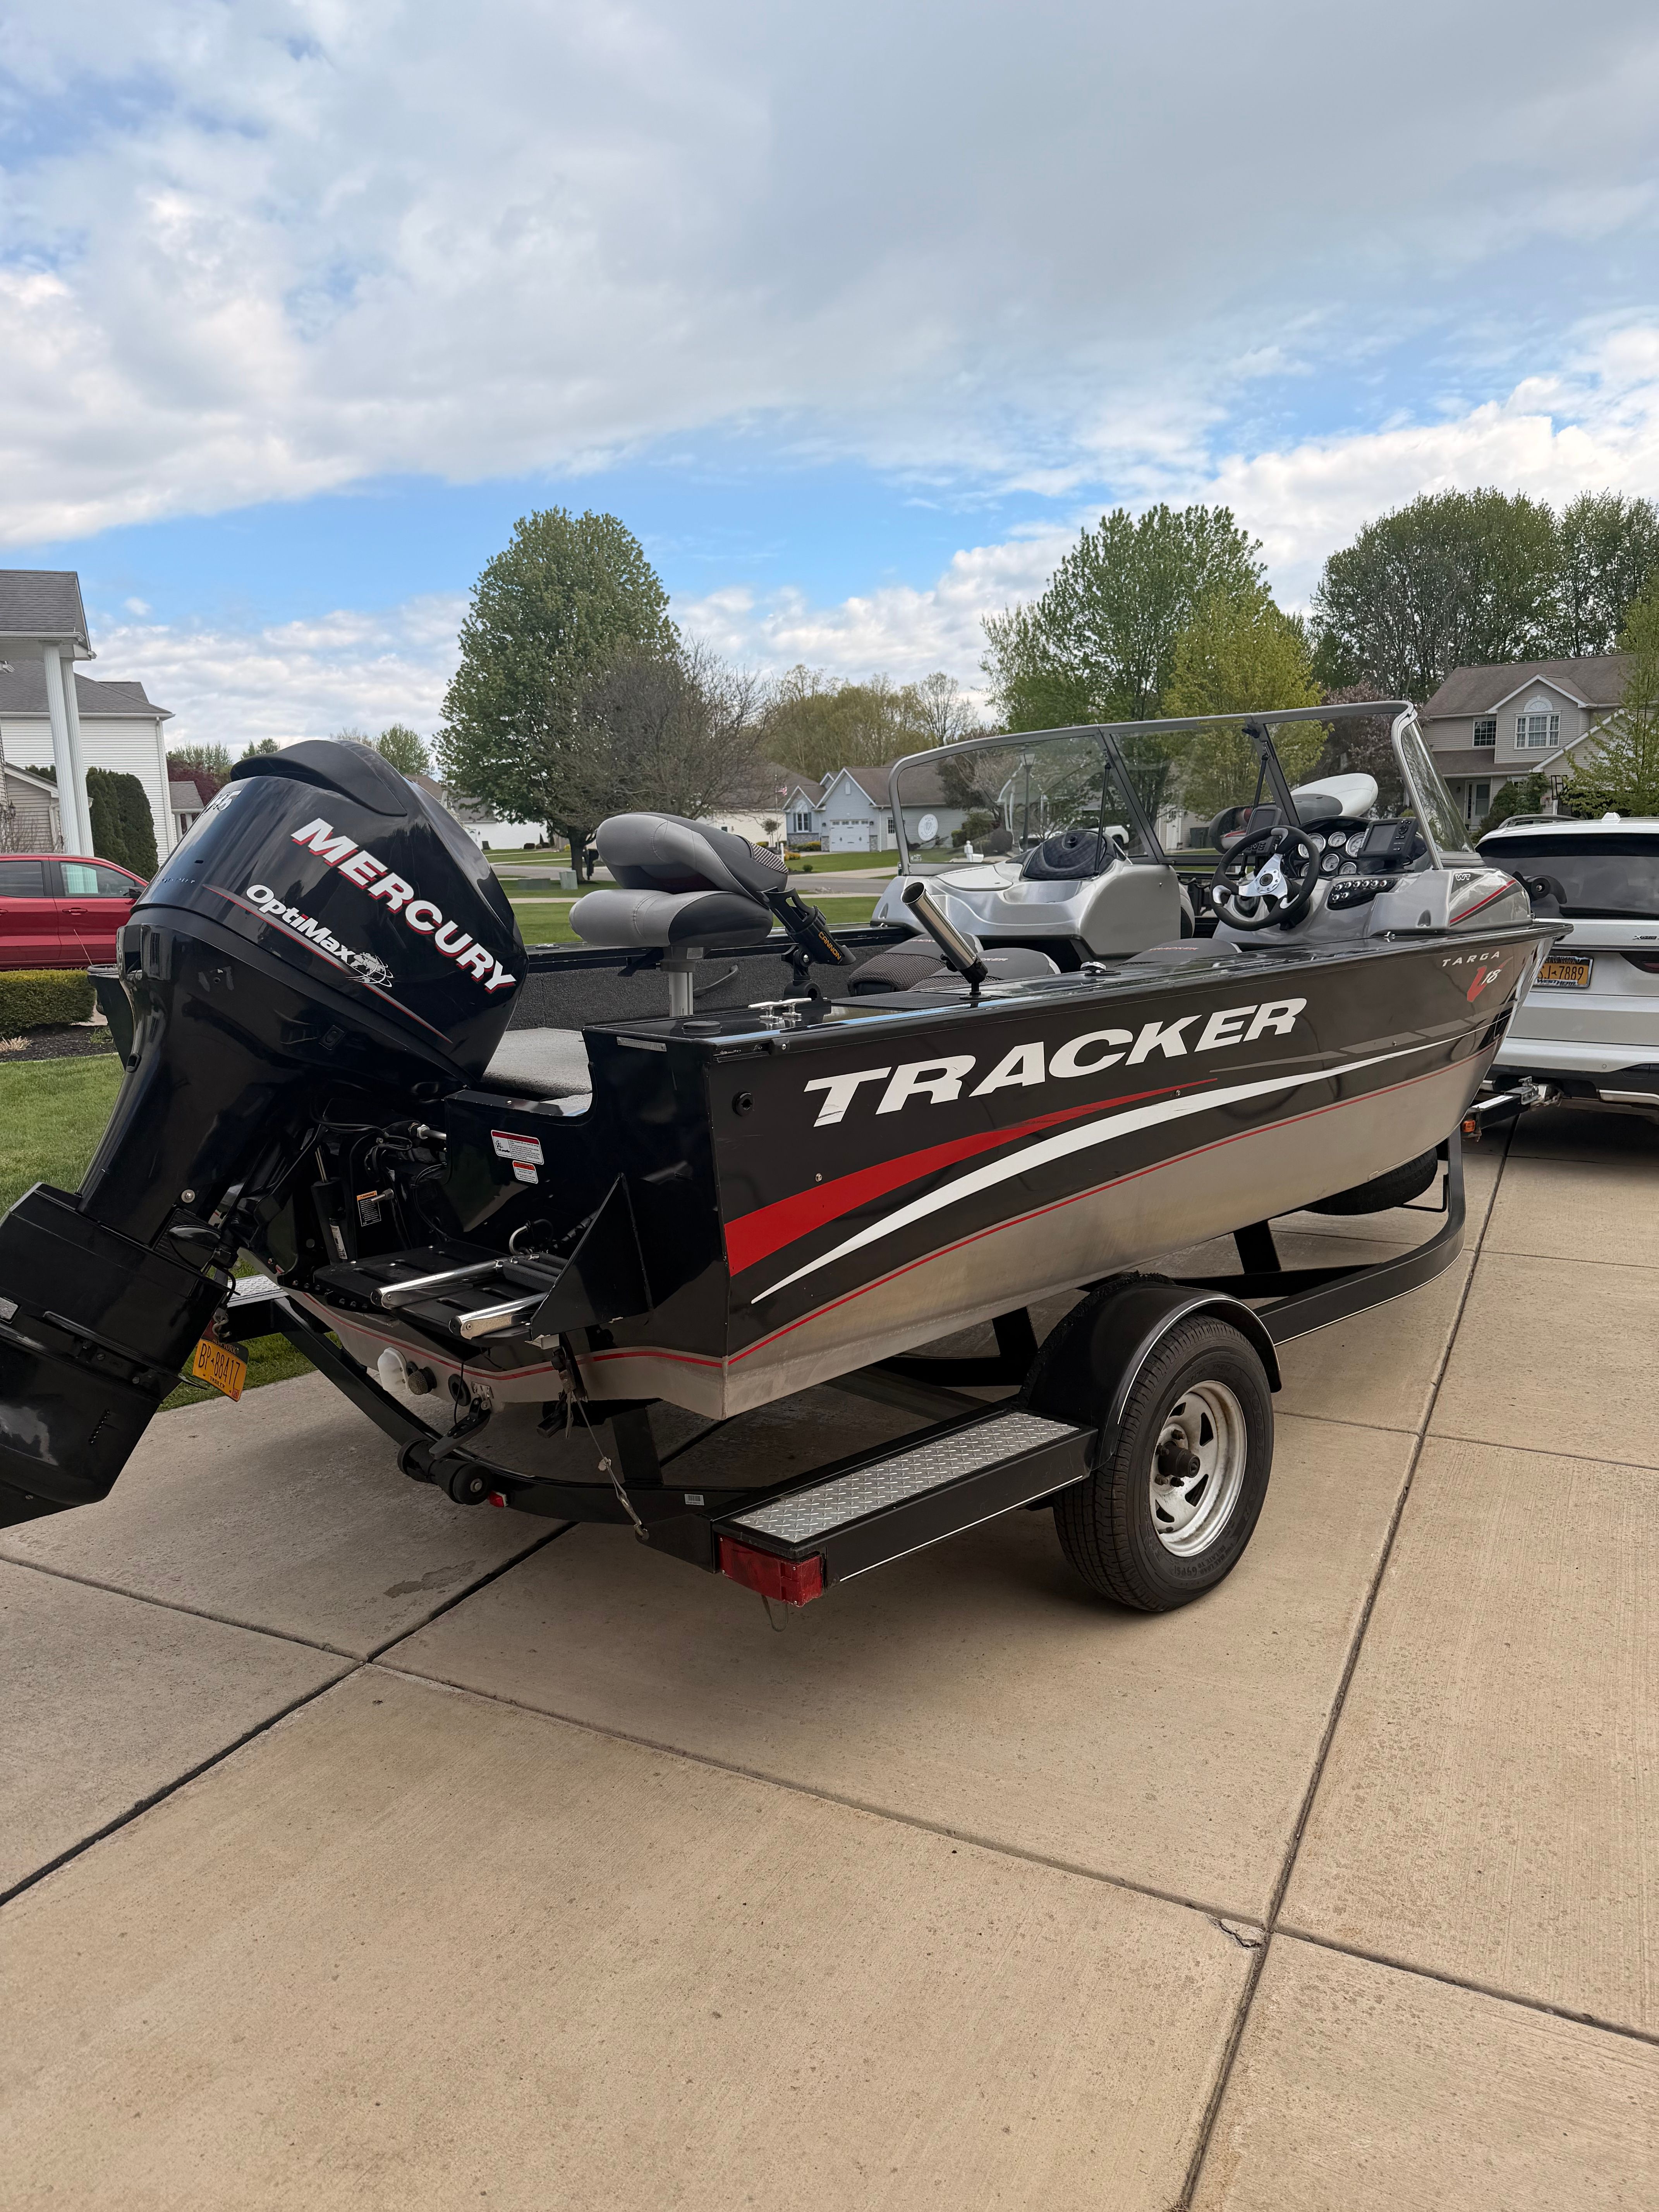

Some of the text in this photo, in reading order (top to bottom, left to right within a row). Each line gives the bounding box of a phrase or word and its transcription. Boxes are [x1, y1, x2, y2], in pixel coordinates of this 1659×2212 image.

[246, 884, 356, 962] OptiMax
[290, 818, 516, 994] MERCURY
[818, 931, 842, 960] CANNON
[1442, 951, 1500, 967] TARGA
[1559, 966, 1584, 984] 7889
[804, 998, 1307, 1127] TRACKER
[198, 1343, 240, 1389] BP 88417
[210, 1376, 225, 1388] TRAILER
